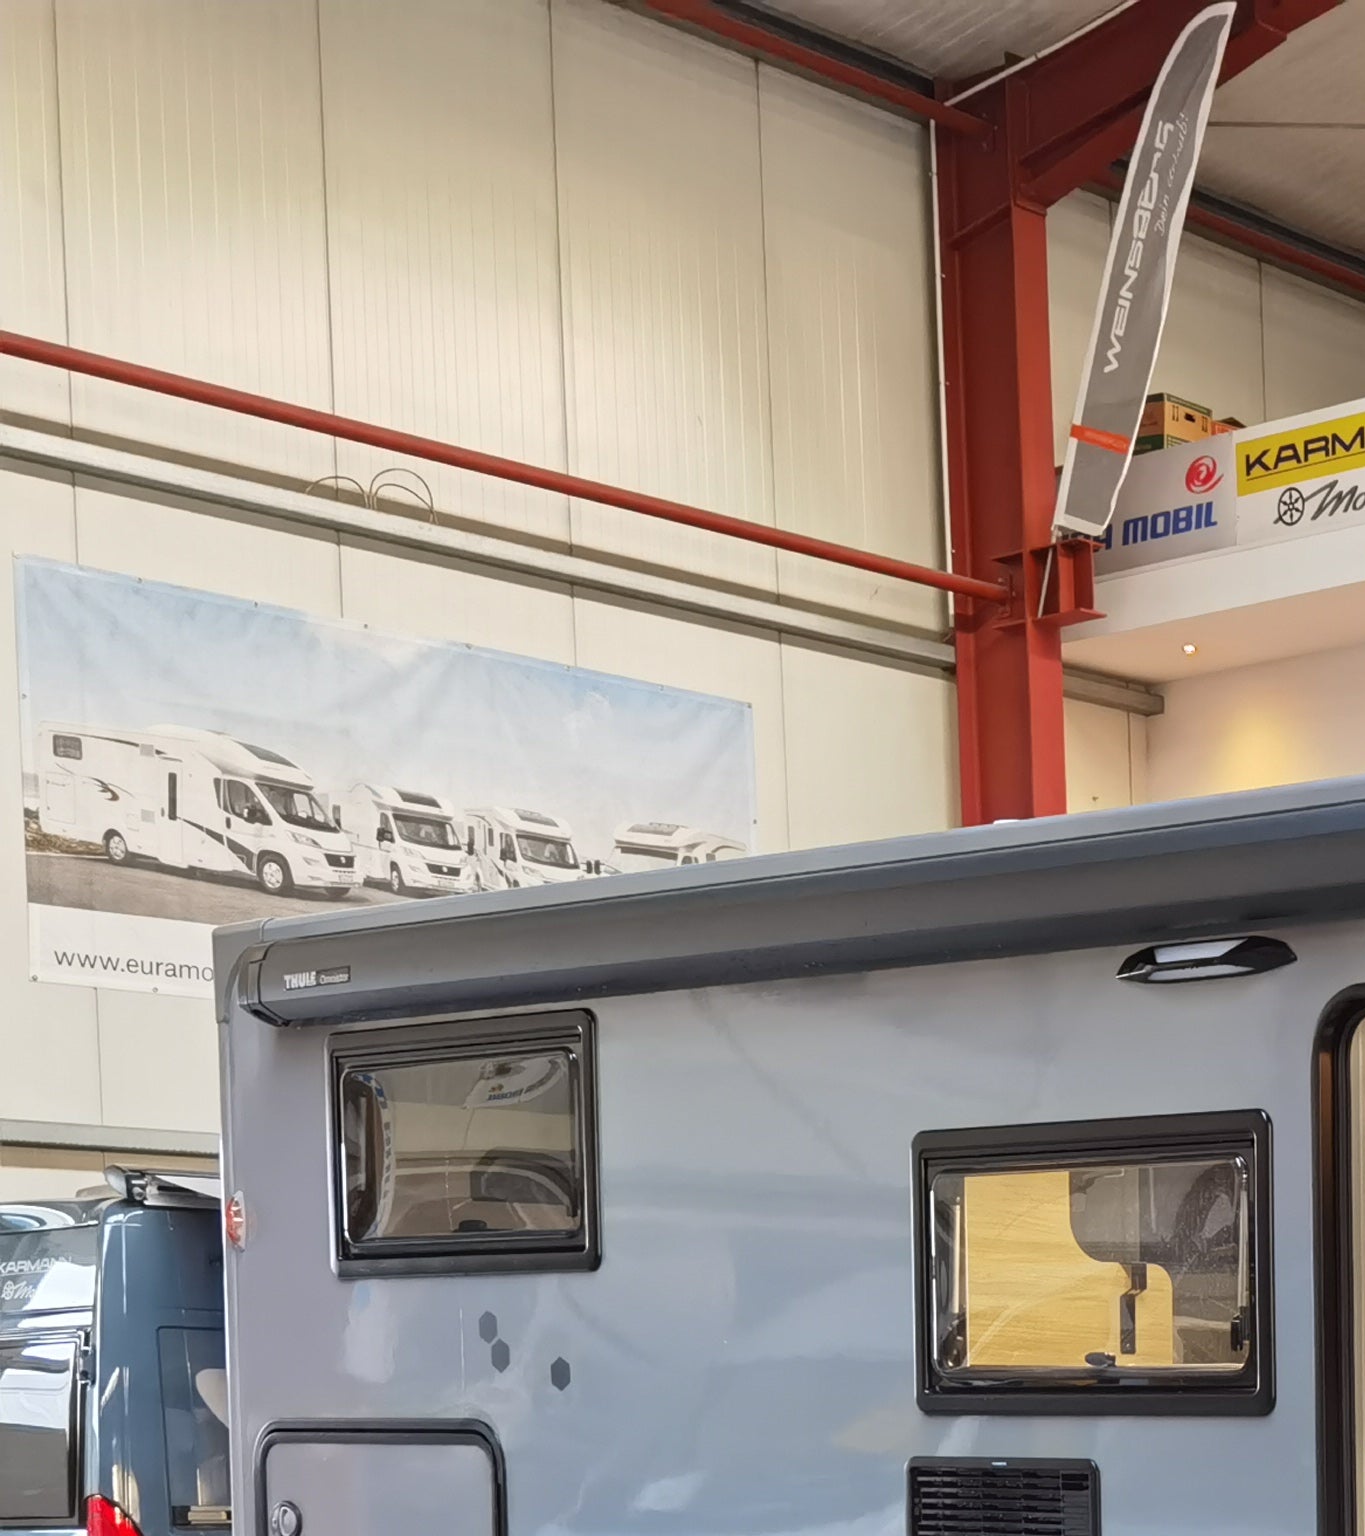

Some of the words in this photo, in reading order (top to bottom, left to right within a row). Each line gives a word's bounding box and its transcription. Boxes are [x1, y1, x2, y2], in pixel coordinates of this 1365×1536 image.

[1103, 120, 1175, 374] WEINSBERG
[1121, 500, 1218, 546] MOBIL
[283, 971, 317, 989] THULE
[0, 1256, 72, 1273] KARMA
